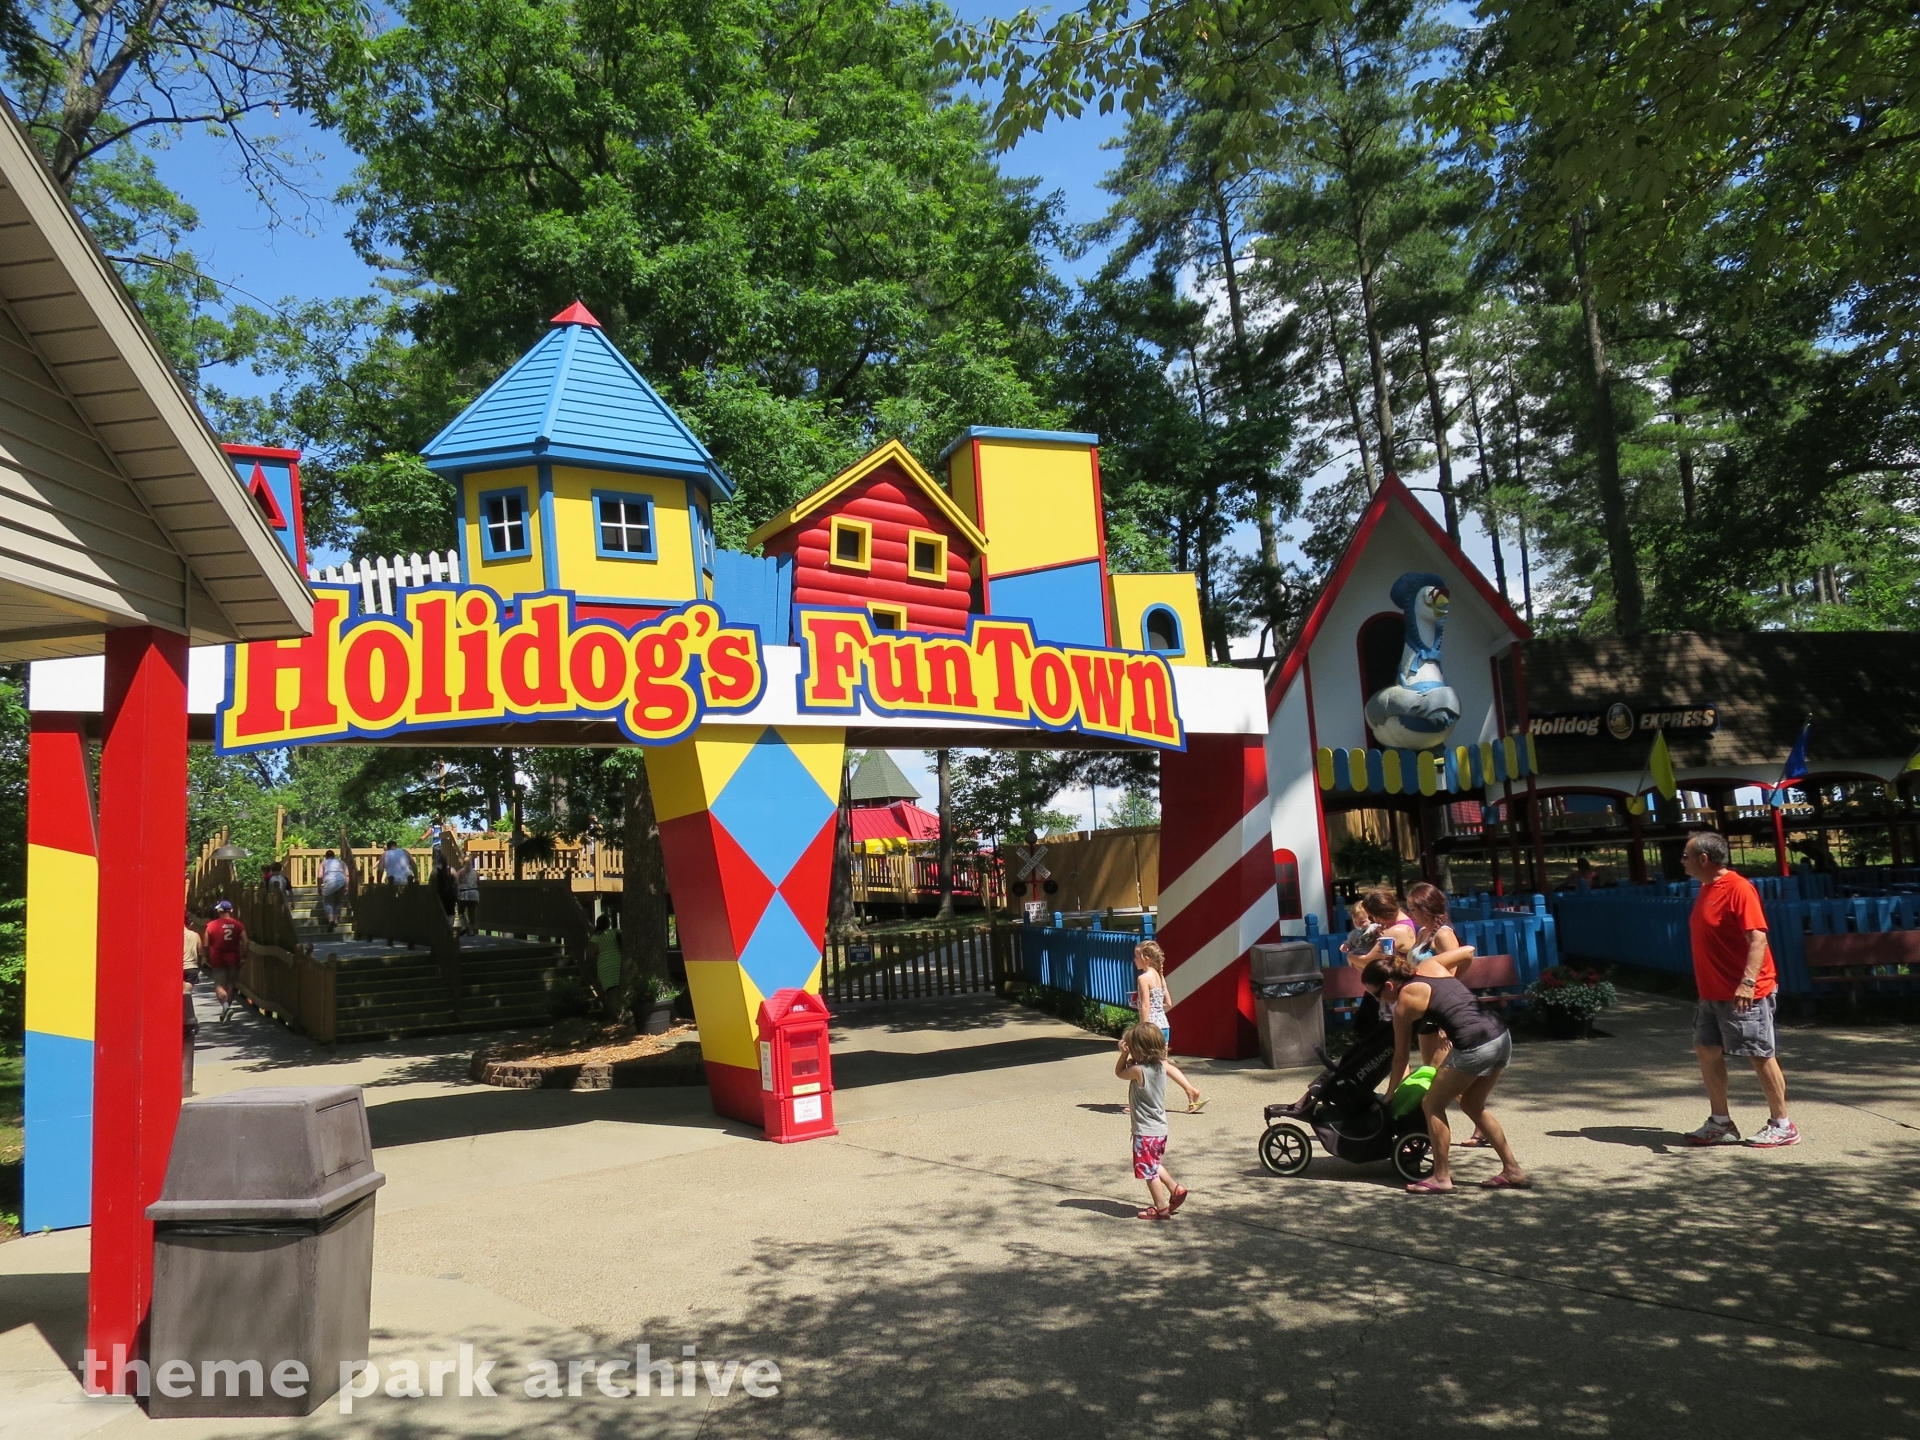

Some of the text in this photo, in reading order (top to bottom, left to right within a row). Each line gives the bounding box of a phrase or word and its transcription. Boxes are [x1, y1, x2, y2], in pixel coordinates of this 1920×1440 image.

[235, 596, 1175, 740] Holidog's FunTown
[1529, 709, 1715, 736] Holidog EXPRESS
[1018, 847, 1047, 879] CROSSING
[1026, 902, 1046, 910] STOP
[223, 929, 233, 940] 2
